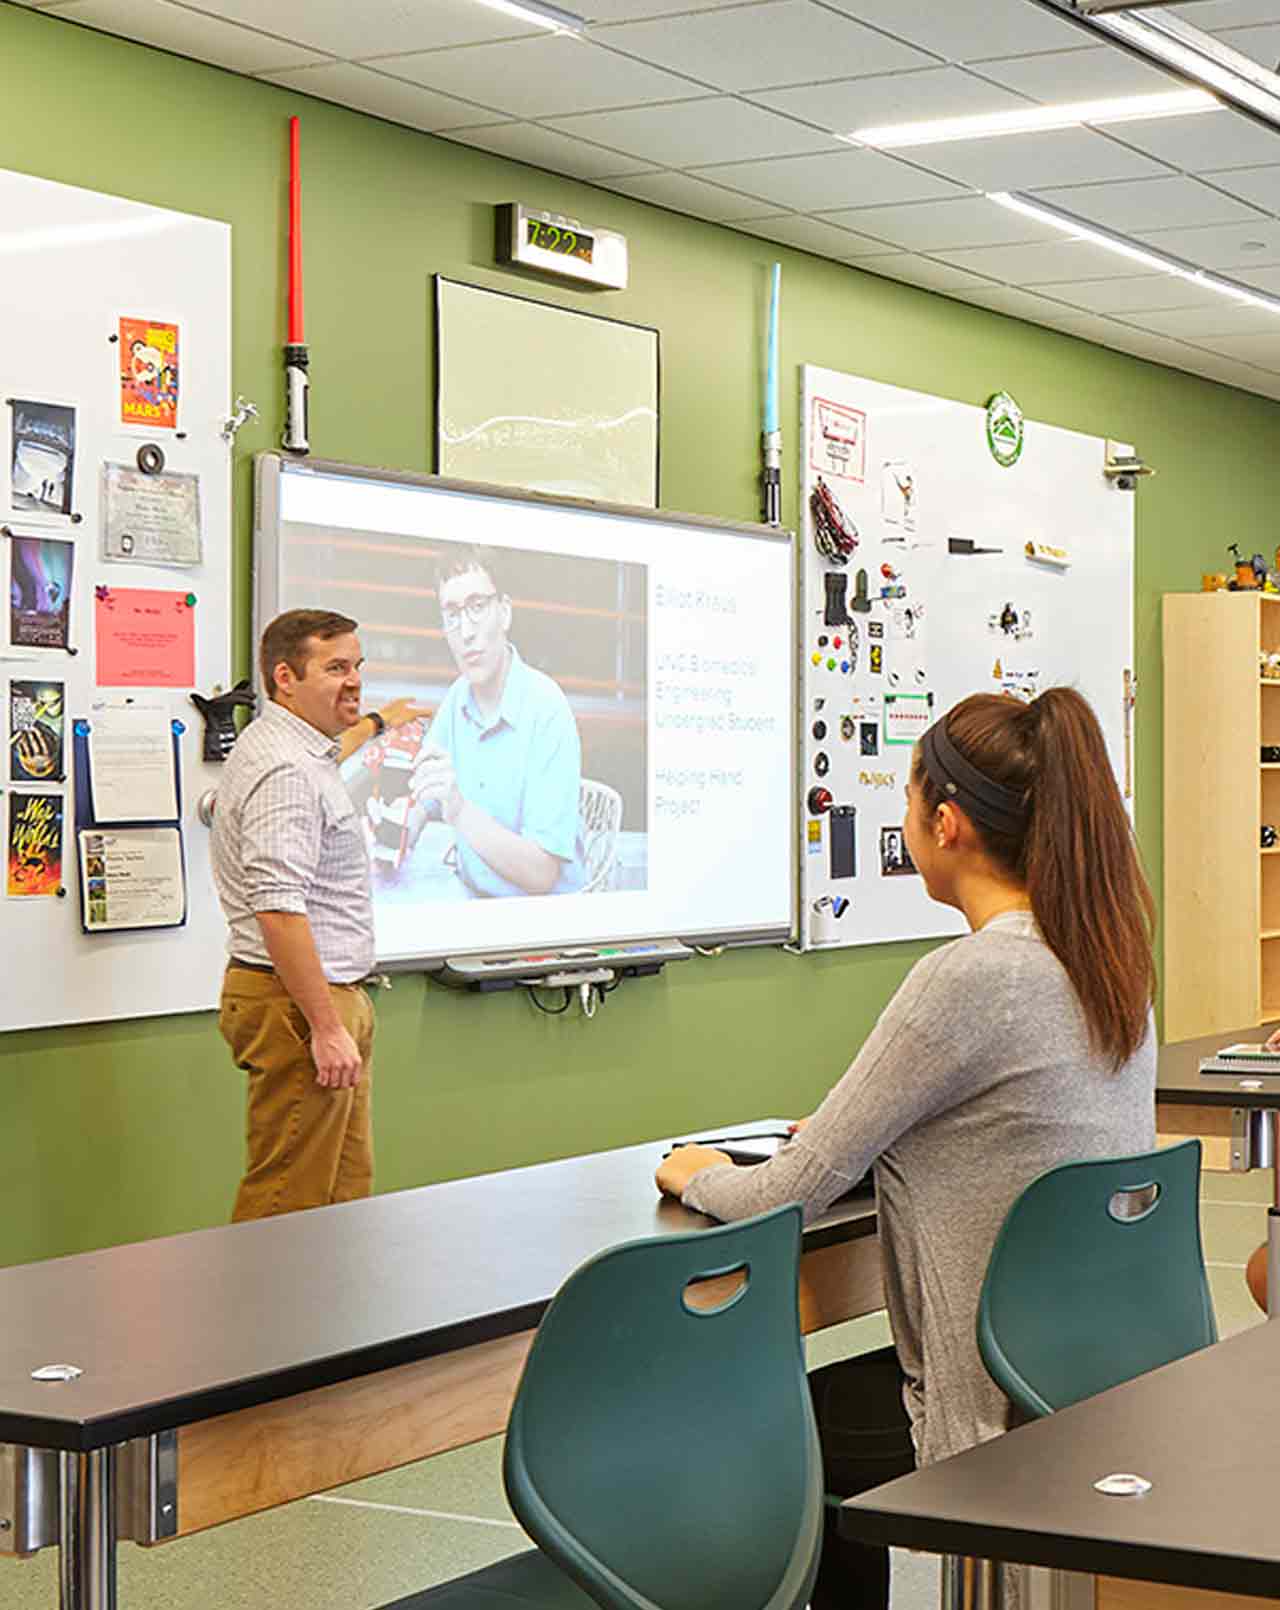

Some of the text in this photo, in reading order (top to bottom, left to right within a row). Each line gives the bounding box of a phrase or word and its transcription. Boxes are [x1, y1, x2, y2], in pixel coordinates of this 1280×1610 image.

[528, 219, 578, 255] 7:22
[123, 400, 161, 417] MARS
[655, 680, 734, 708] Engineering
[655, 711, 776, 734] Undergrad Student
[655, 768, 744, 791] Helping Hand
[655, 795, 702, 823] Project
